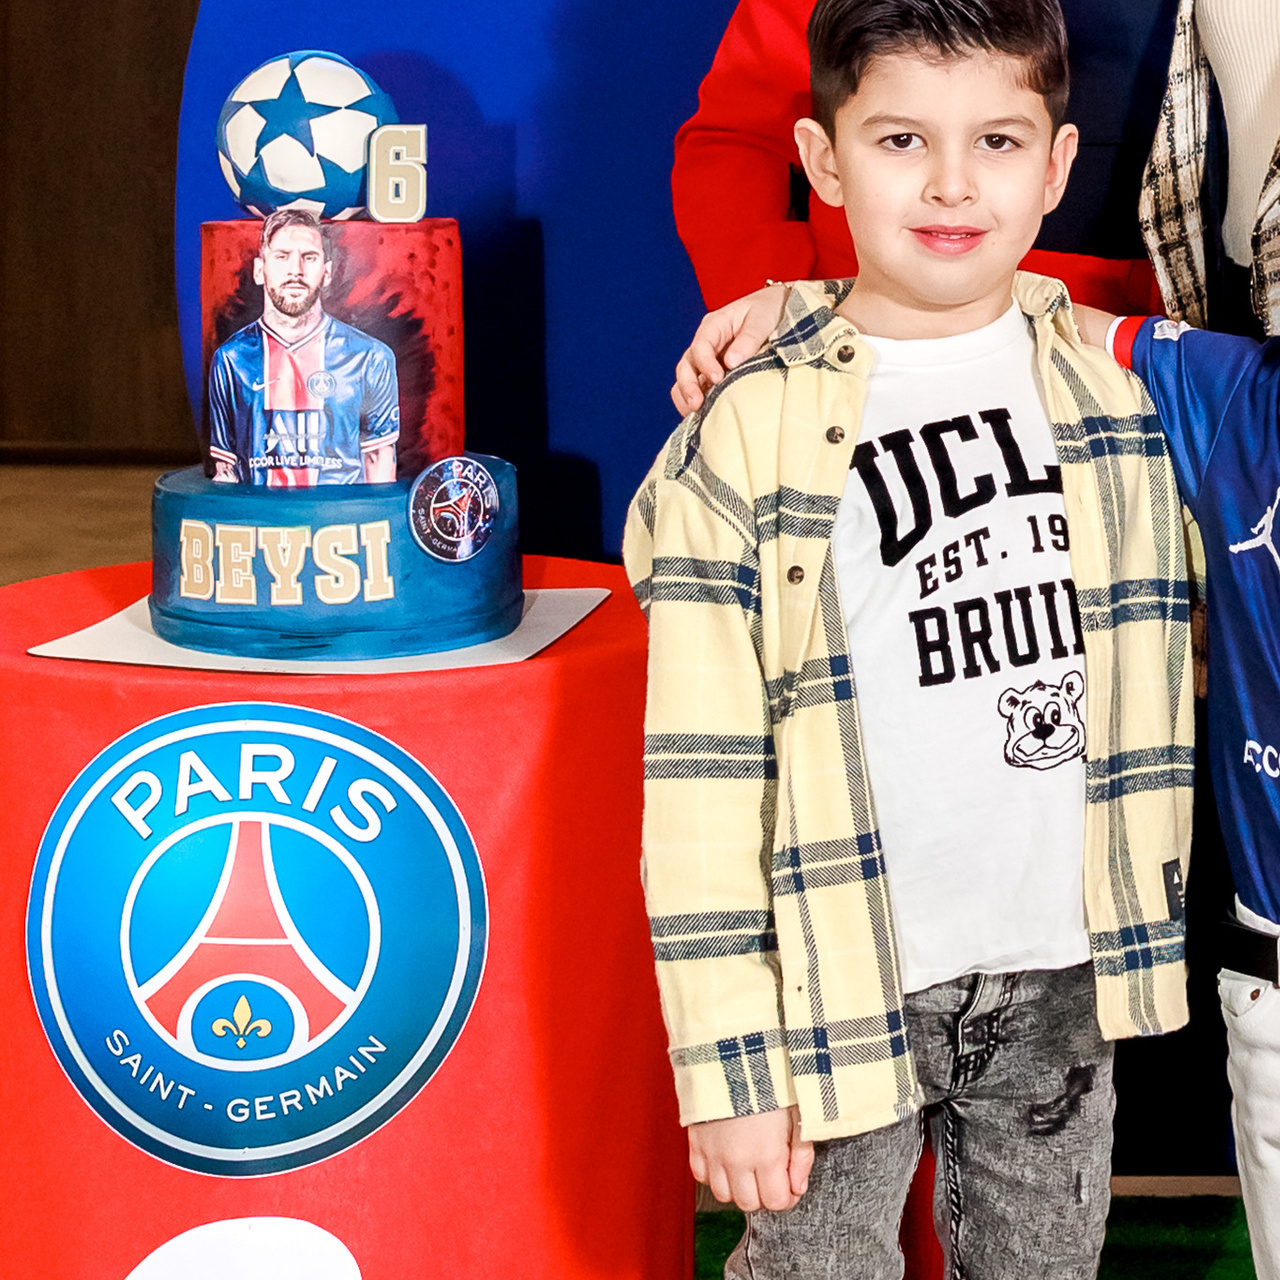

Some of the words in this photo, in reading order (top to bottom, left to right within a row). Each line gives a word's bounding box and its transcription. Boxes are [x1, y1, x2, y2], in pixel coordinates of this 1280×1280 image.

[366, 123, 428, 223] 6
[849, 407, 1064, 567] UCL
[179, 518, 395, 605] BEYSI
[916, 527, 1008, 599] EST.
[1027, 514, 1070, 552] 19
[110, 742, 398, 843] PARIS
[105, 1028, 196, 1110] SAINT
[226, 1034, 388, 1123] GERMAIN
